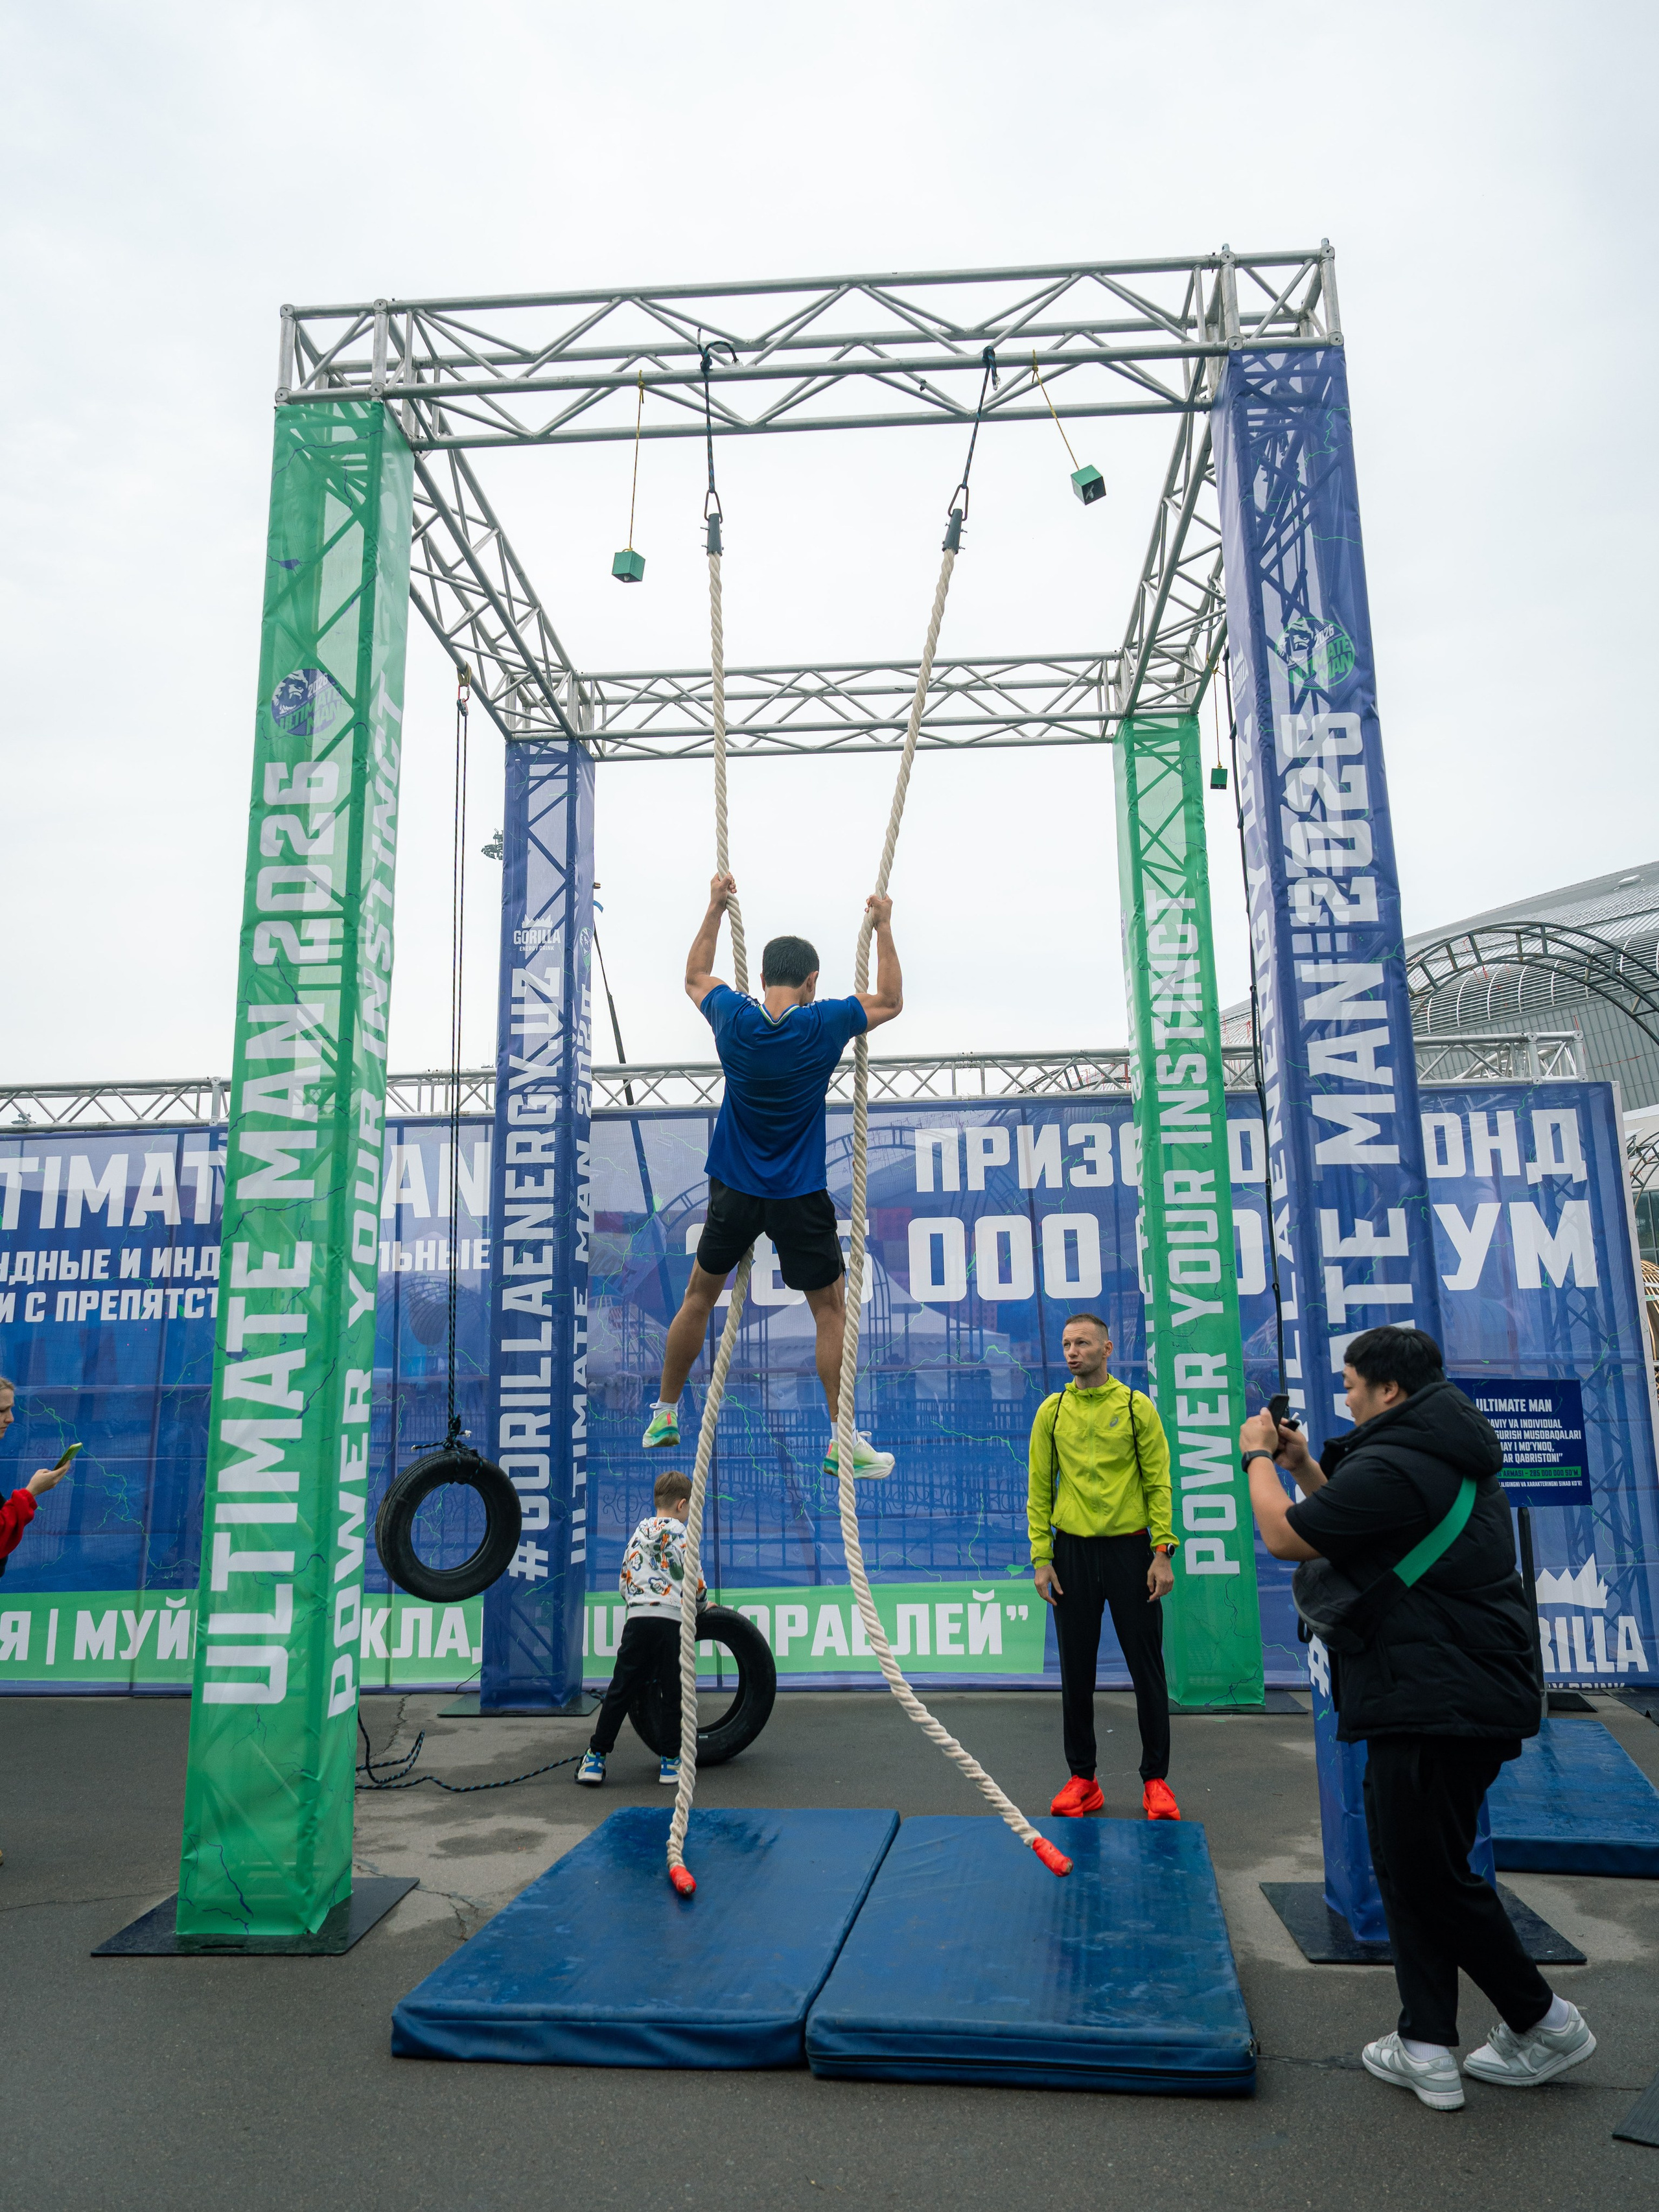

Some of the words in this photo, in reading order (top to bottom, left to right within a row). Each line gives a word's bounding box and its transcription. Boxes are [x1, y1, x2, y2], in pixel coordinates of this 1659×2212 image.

[252, 762, 339, 964] 2026
[361, 669, 402, 1062] INSTINCT
[1281, 712, 1380, 924] 2026
[513, 929, 561, 945] GORILLA
[1145, 889, 1212, 1145] INSTINCT
[236, 1004, 325, 1201] MAN
[1295, 961, 1400, 1165] MAN
[119, 1248, 141, 1279] И
[349, 1084, 388, 1329] YOUR
[499, 966, 561, 1582] #GORILLAENERGY.UZ
[1163, 1169, 1224, 1327] YOUR
[25, 1292, 46, 1322] С
[1476, 1398, 1526, 1412] ULTIMATE
[1528, 1399, 1553, 1412] MAN
[202, 1240, 314, 1705] ULTIMATE
[1174, 1353, 1240, 1576] POWER
[1508, 1419, 1518, 1428] VA
[1520, 1419, 1562, 1428] INDIVIDUAL
[1519, 1441, 1555, 1452] MO'YNOQ,
[1524, 1430, 1582, 1440] MUSOBAQALARI
[73, 1596, 198, 1660] МУЙ
[327, 1368, 373, 1719] POWER
